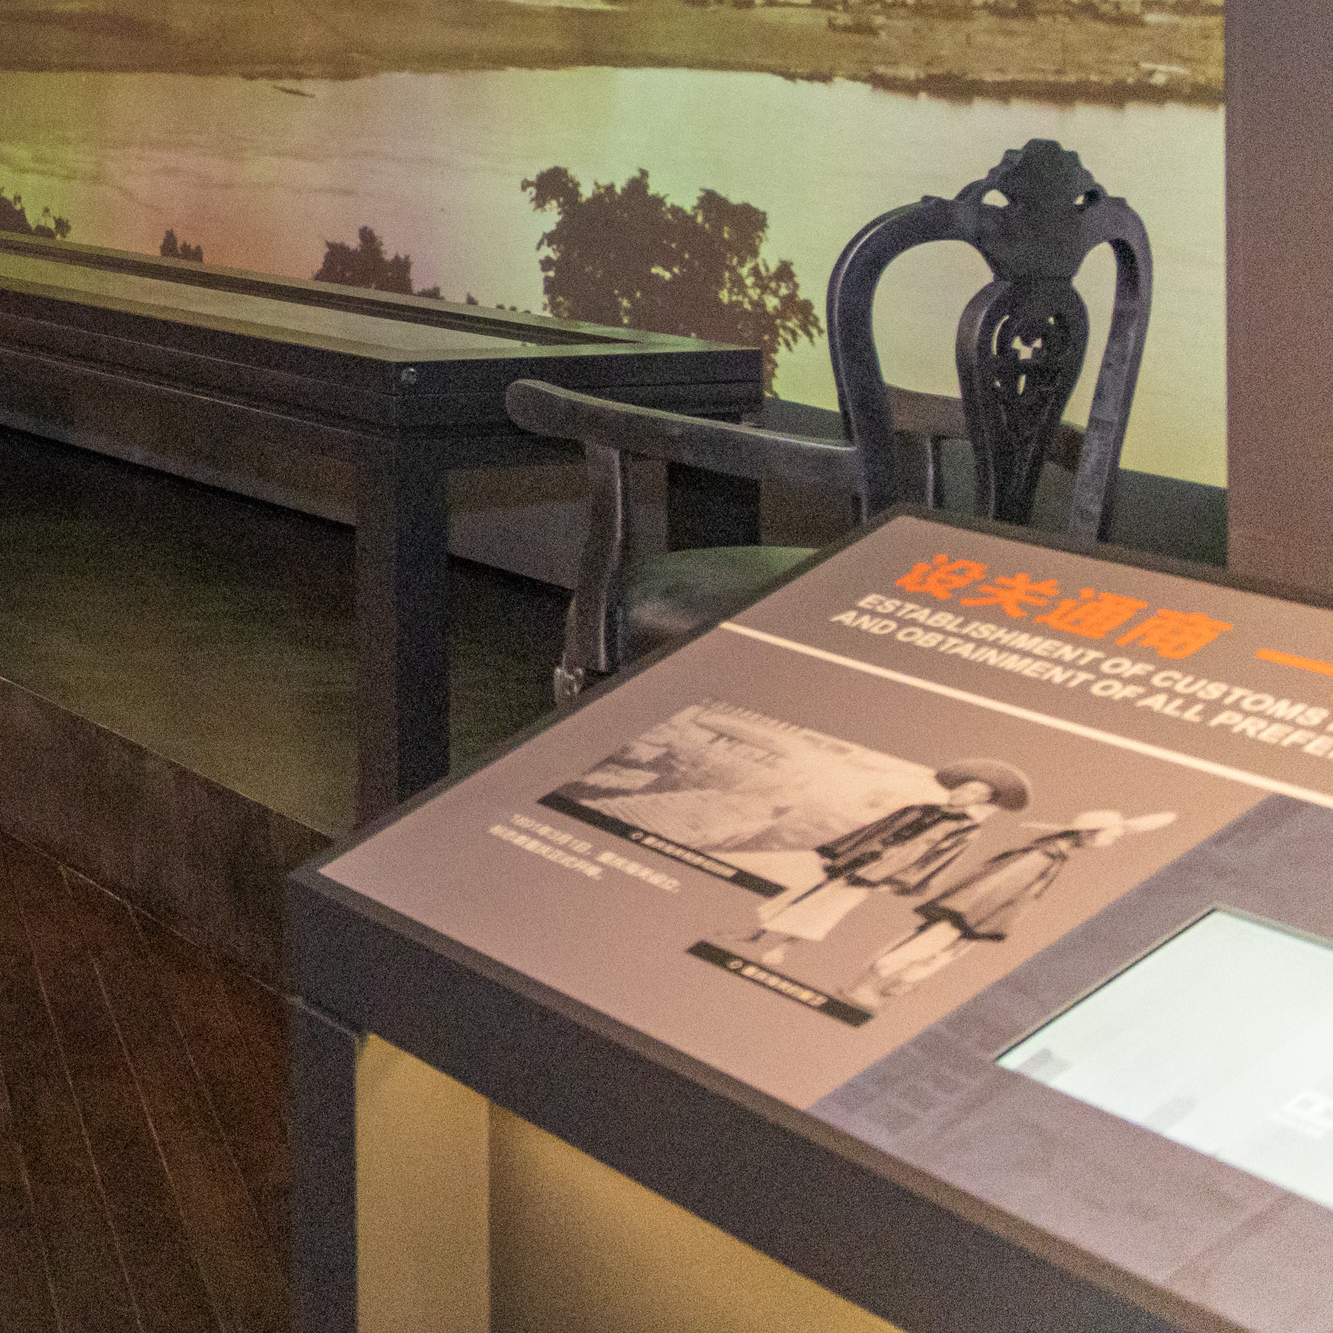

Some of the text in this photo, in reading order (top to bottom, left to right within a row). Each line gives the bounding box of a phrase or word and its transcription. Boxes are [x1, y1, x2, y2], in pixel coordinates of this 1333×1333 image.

[857, 593, 1329, 727] ESTABLISHMENT OF CUSTOMS
[895, 554, 1233, 659] 设关通商
[831, 610, 1333, 759] AND OBTAINMENT OF ALL PREFE
